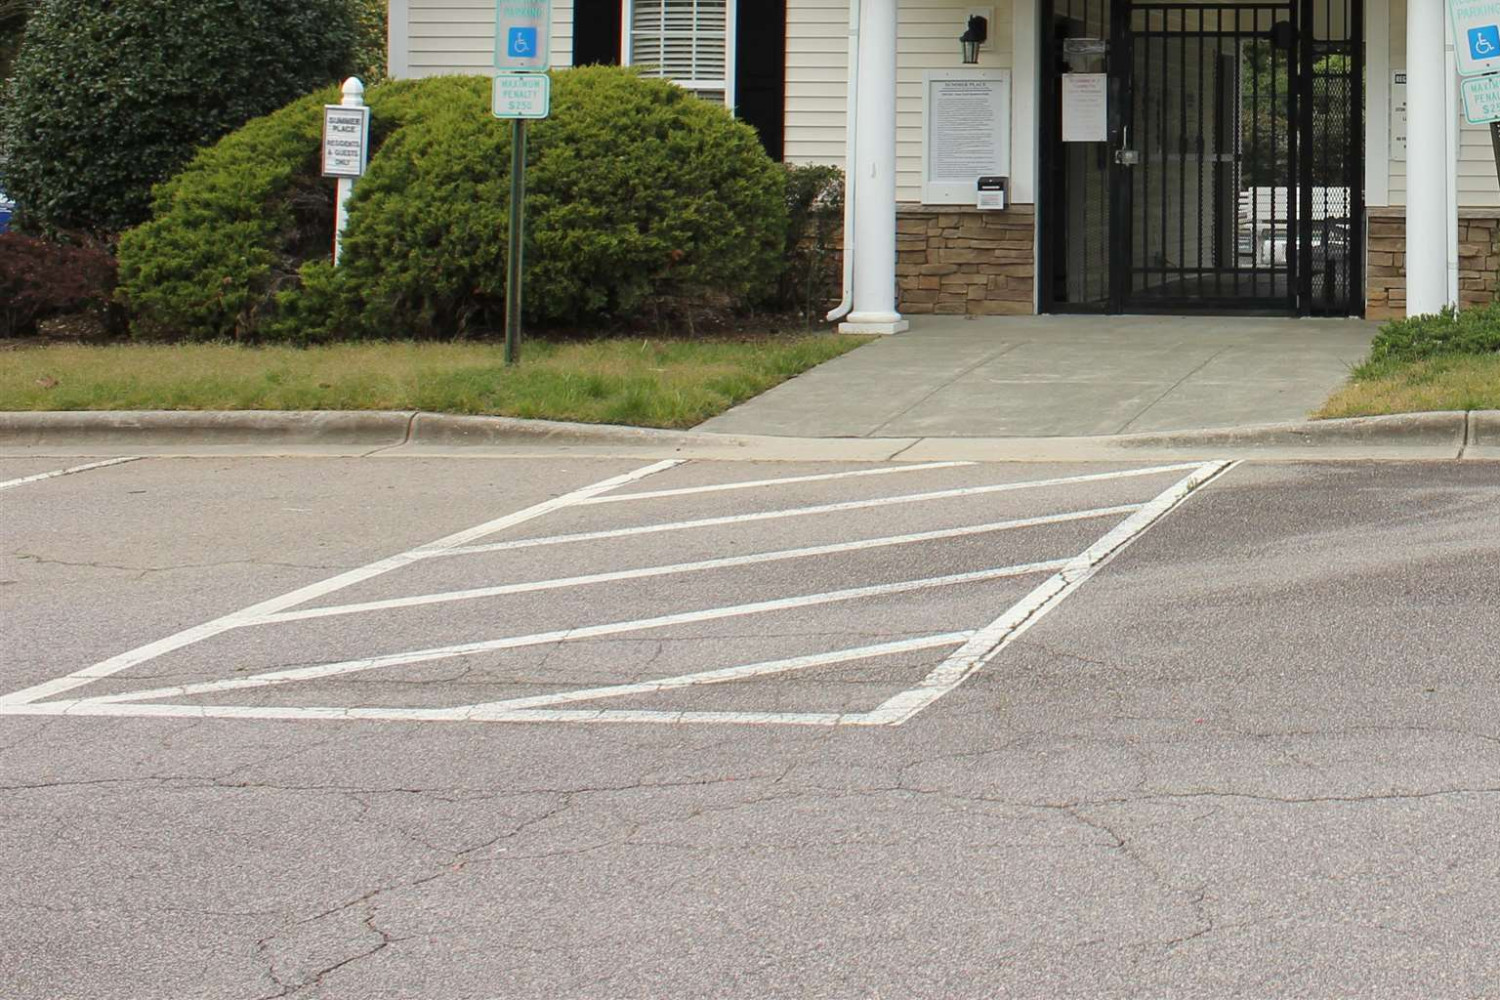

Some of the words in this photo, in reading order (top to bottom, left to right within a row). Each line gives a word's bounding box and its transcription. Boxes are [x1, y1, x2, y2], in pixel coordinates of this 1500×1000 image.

[501, 90, 537, 98] PENALTY
[328, 117, 361, 125] SUMMER
[333, 125, 356, 133] PLACE
[327, 139, 360, 147] RESIDENTS
